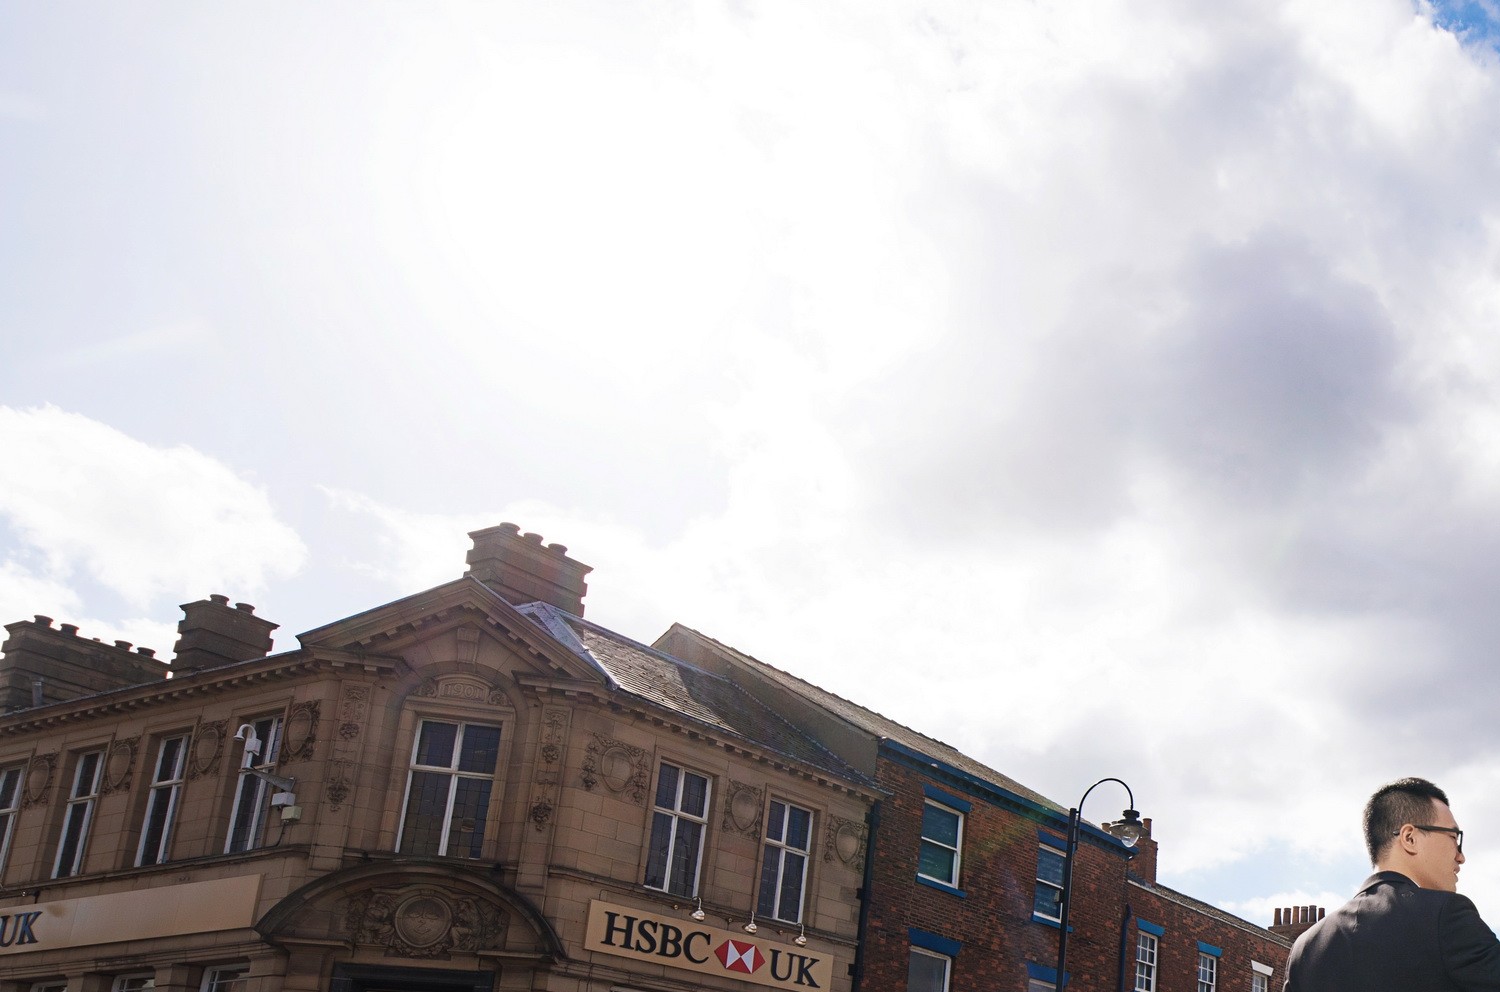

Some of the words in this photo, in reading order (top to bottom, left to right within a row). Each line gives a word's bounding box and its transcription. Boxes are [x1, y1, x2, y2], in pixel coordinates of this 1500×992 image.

[0, 911, 43, 947] UK
[600, 910, 711, 964] HSBC
[769, 948, 821, 989] UK
